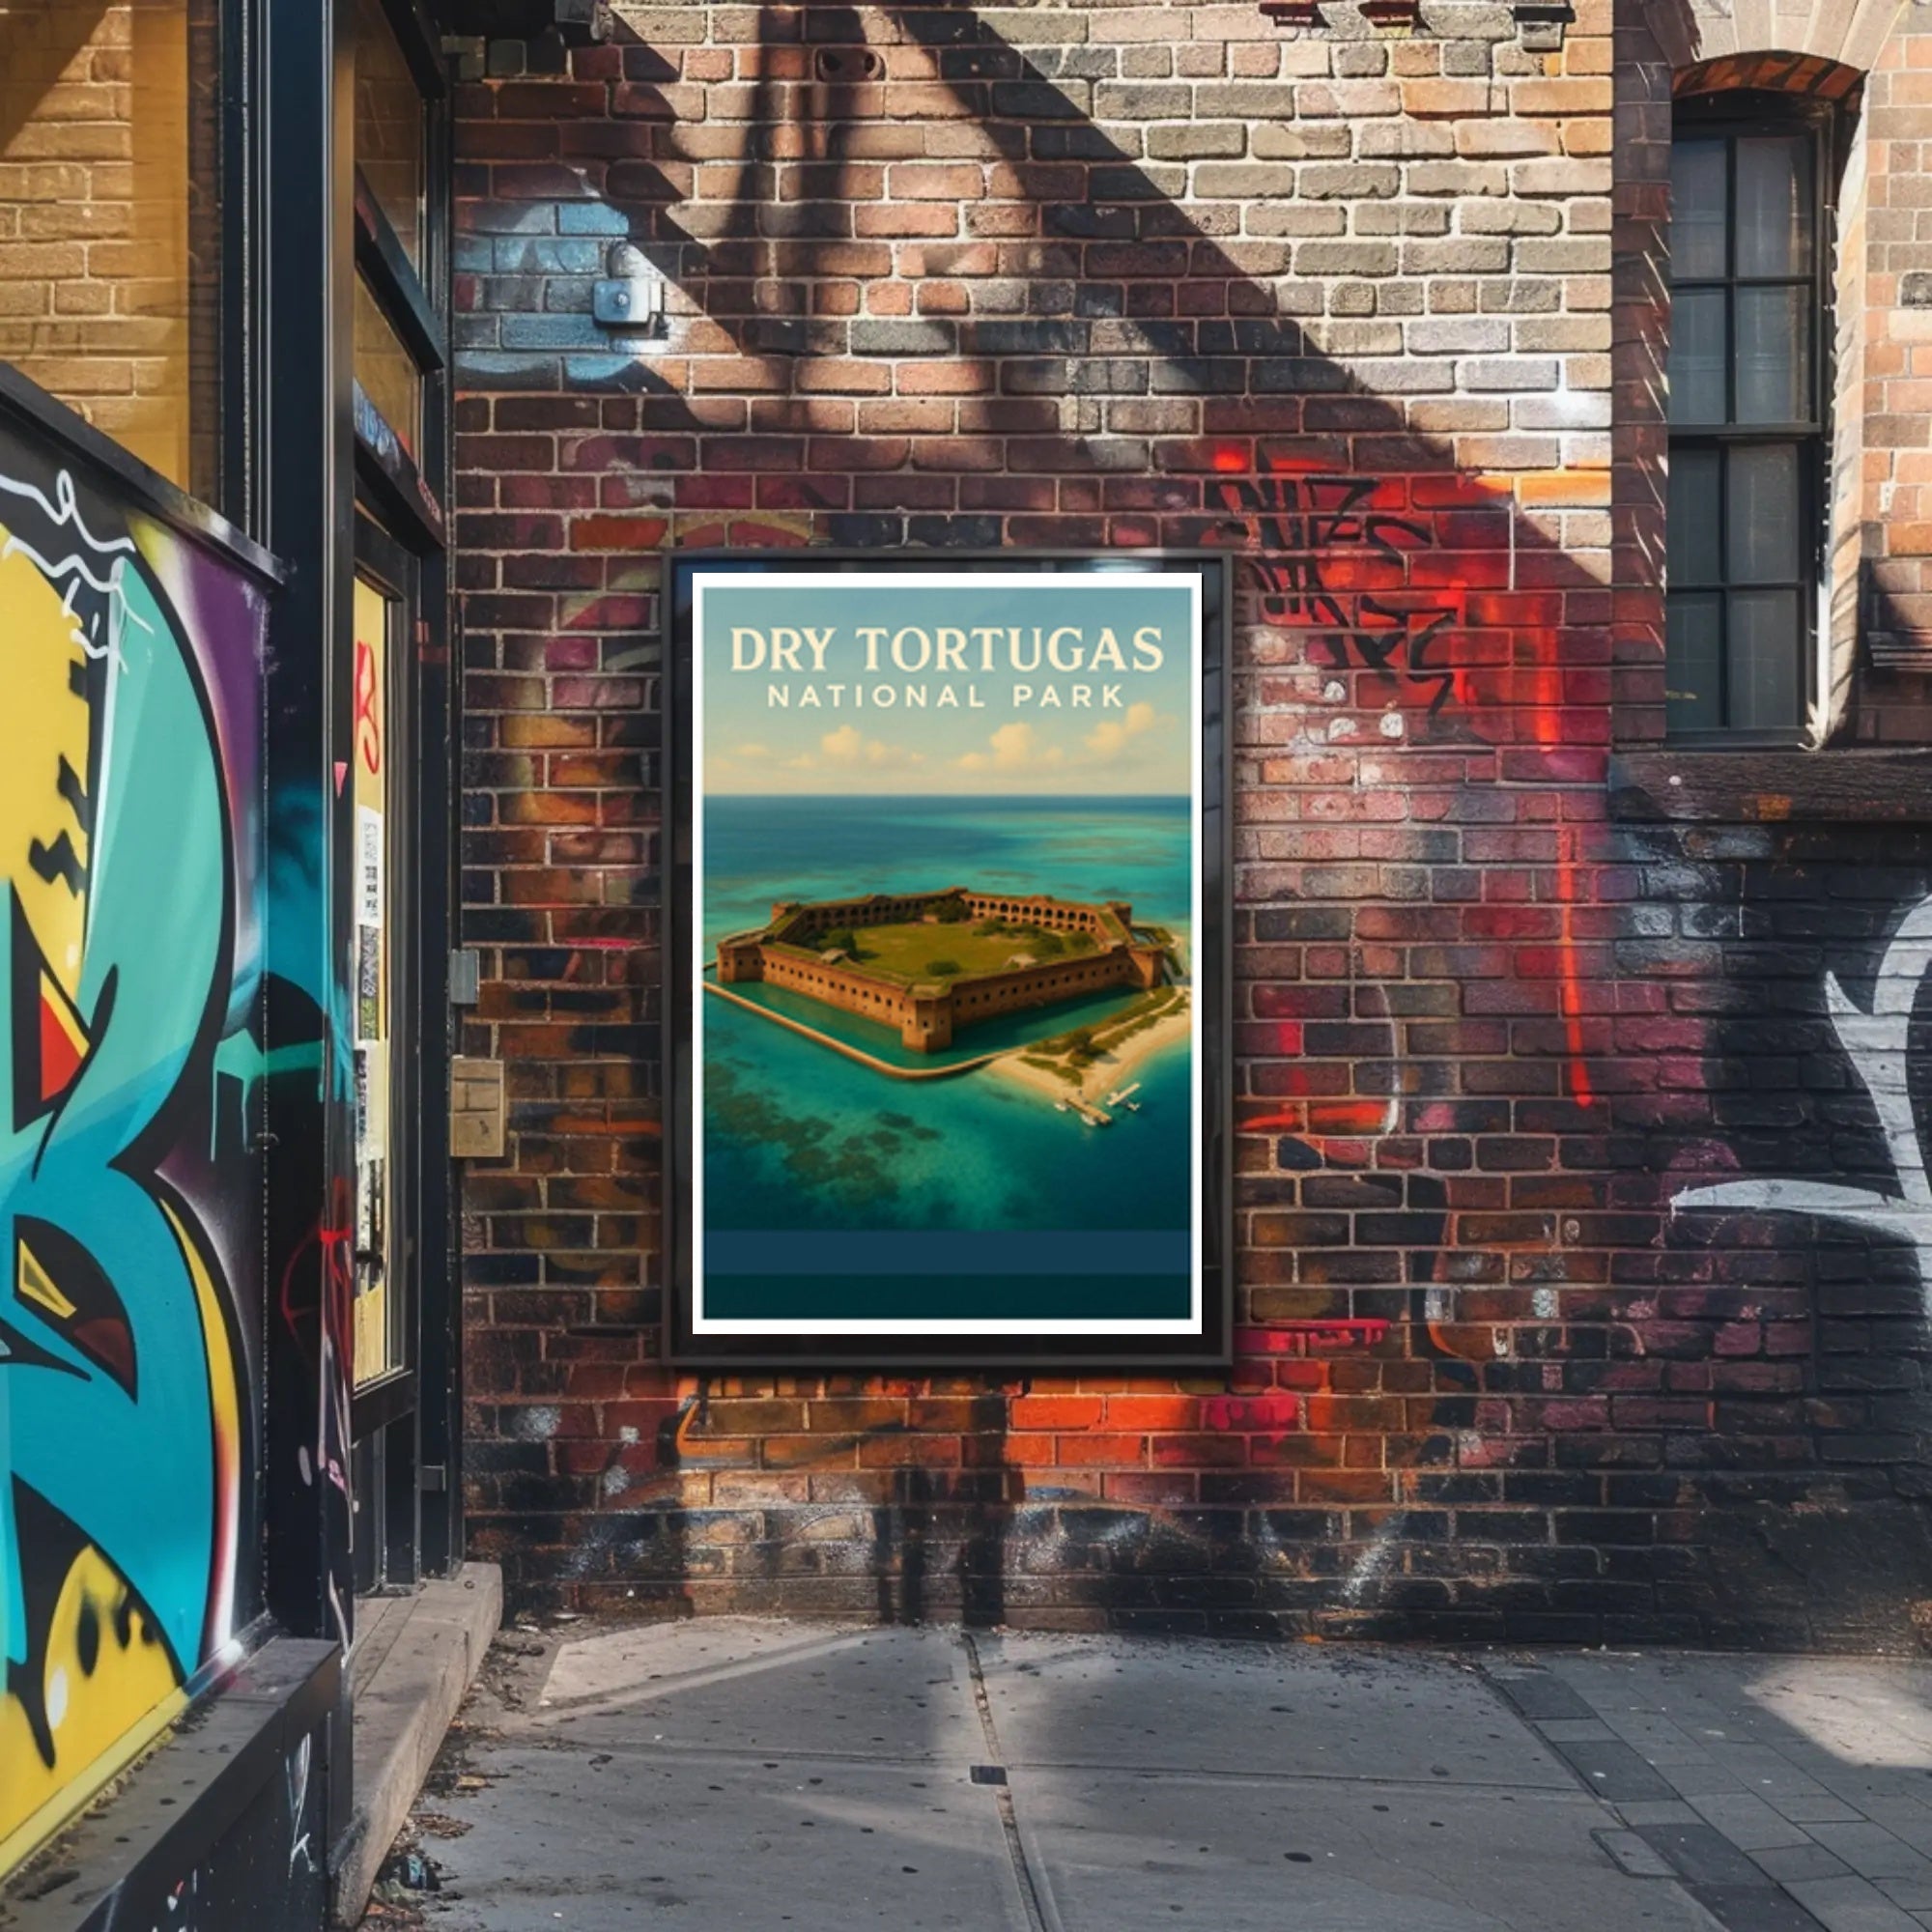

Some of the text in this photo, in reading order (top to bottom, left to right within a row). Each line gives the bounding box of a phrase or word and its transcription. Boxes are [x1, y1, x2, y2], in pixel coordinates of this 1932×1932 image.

[731, 627, 1164, 672] DRY TORTUGAS
[767, 684, 1124, 708] NATIONAL PARK
